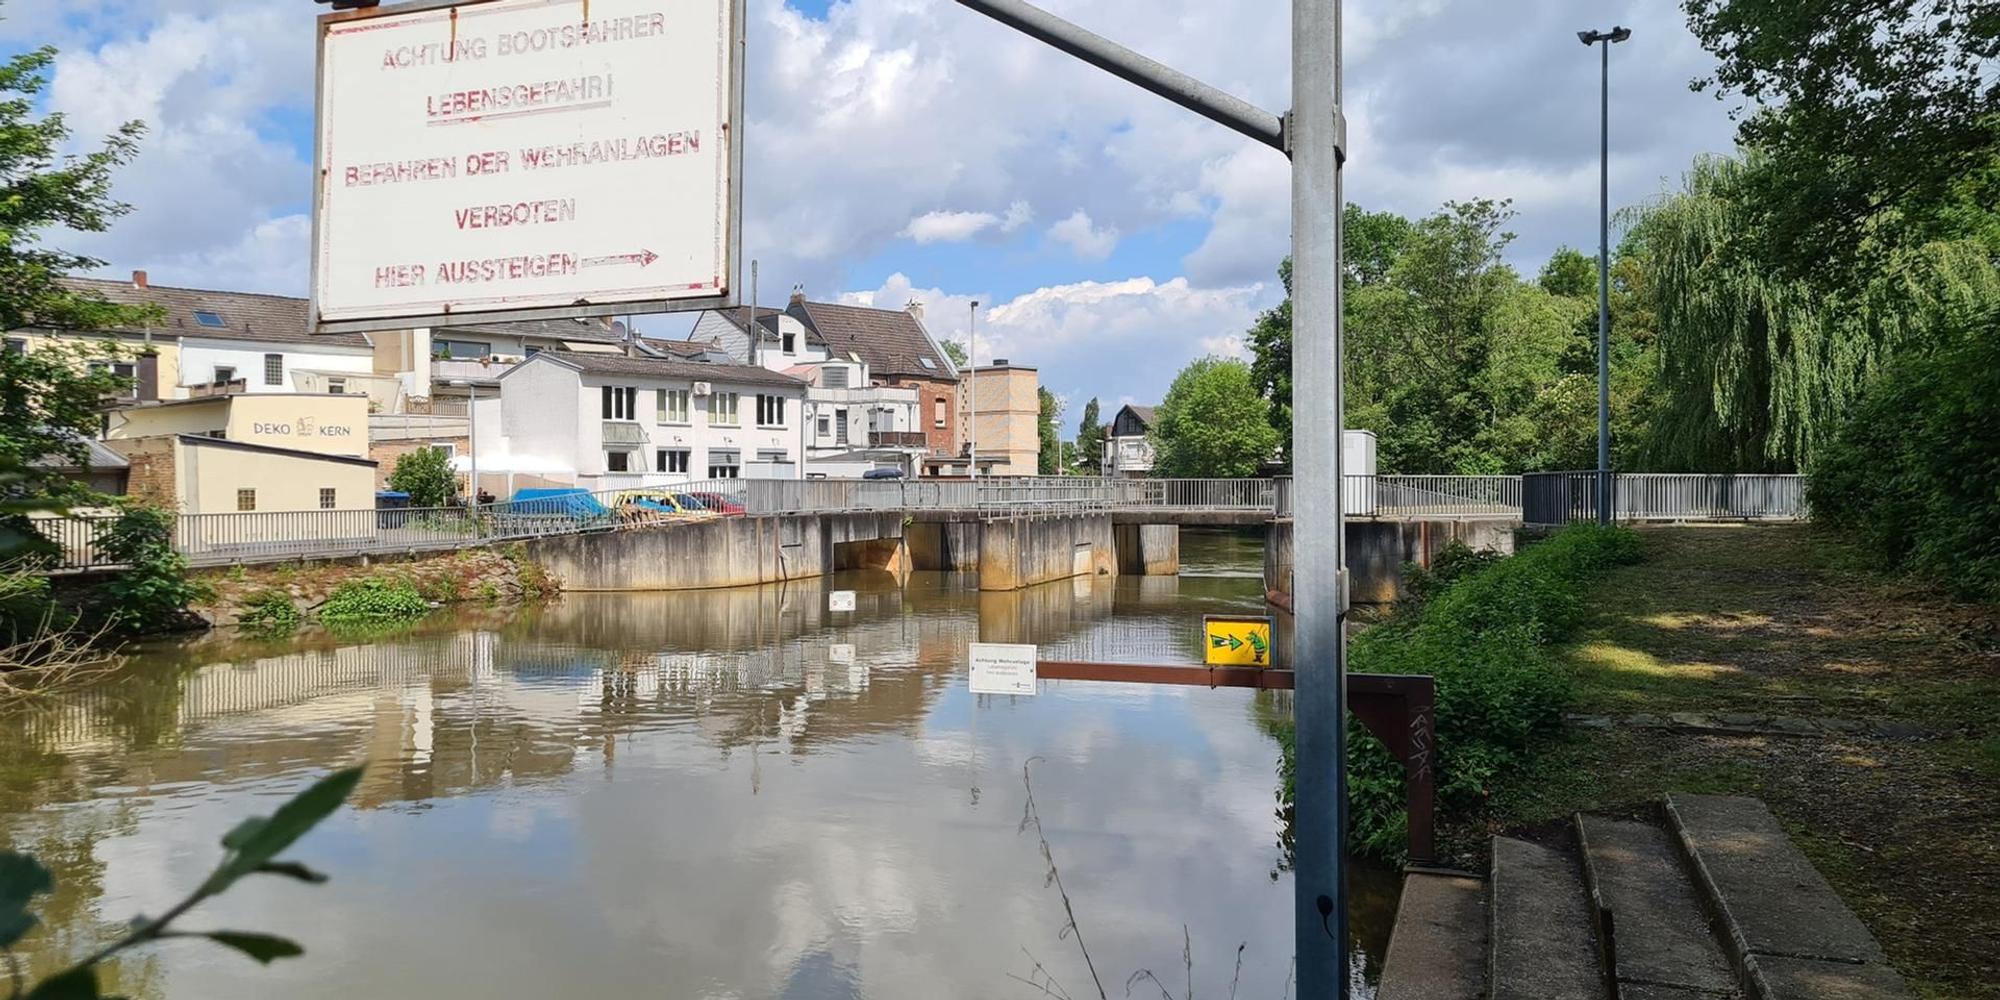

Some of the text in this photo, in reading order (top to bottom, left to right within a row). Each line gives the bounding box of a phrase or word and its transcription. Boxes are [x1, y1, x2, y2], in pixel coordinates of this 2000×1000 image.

[381, 12, 666, 71] ACHTUNG BOOTSFAHRER
[345, 130, 701, 187] BEFAHREN DER WEHRANLAGEN
[455, 198, 576, 230] VERBOTEN
[375, 252, 578, 289] HIER AUSSTEIGEN
[253, 422, 350, 436] DEKO KERN
